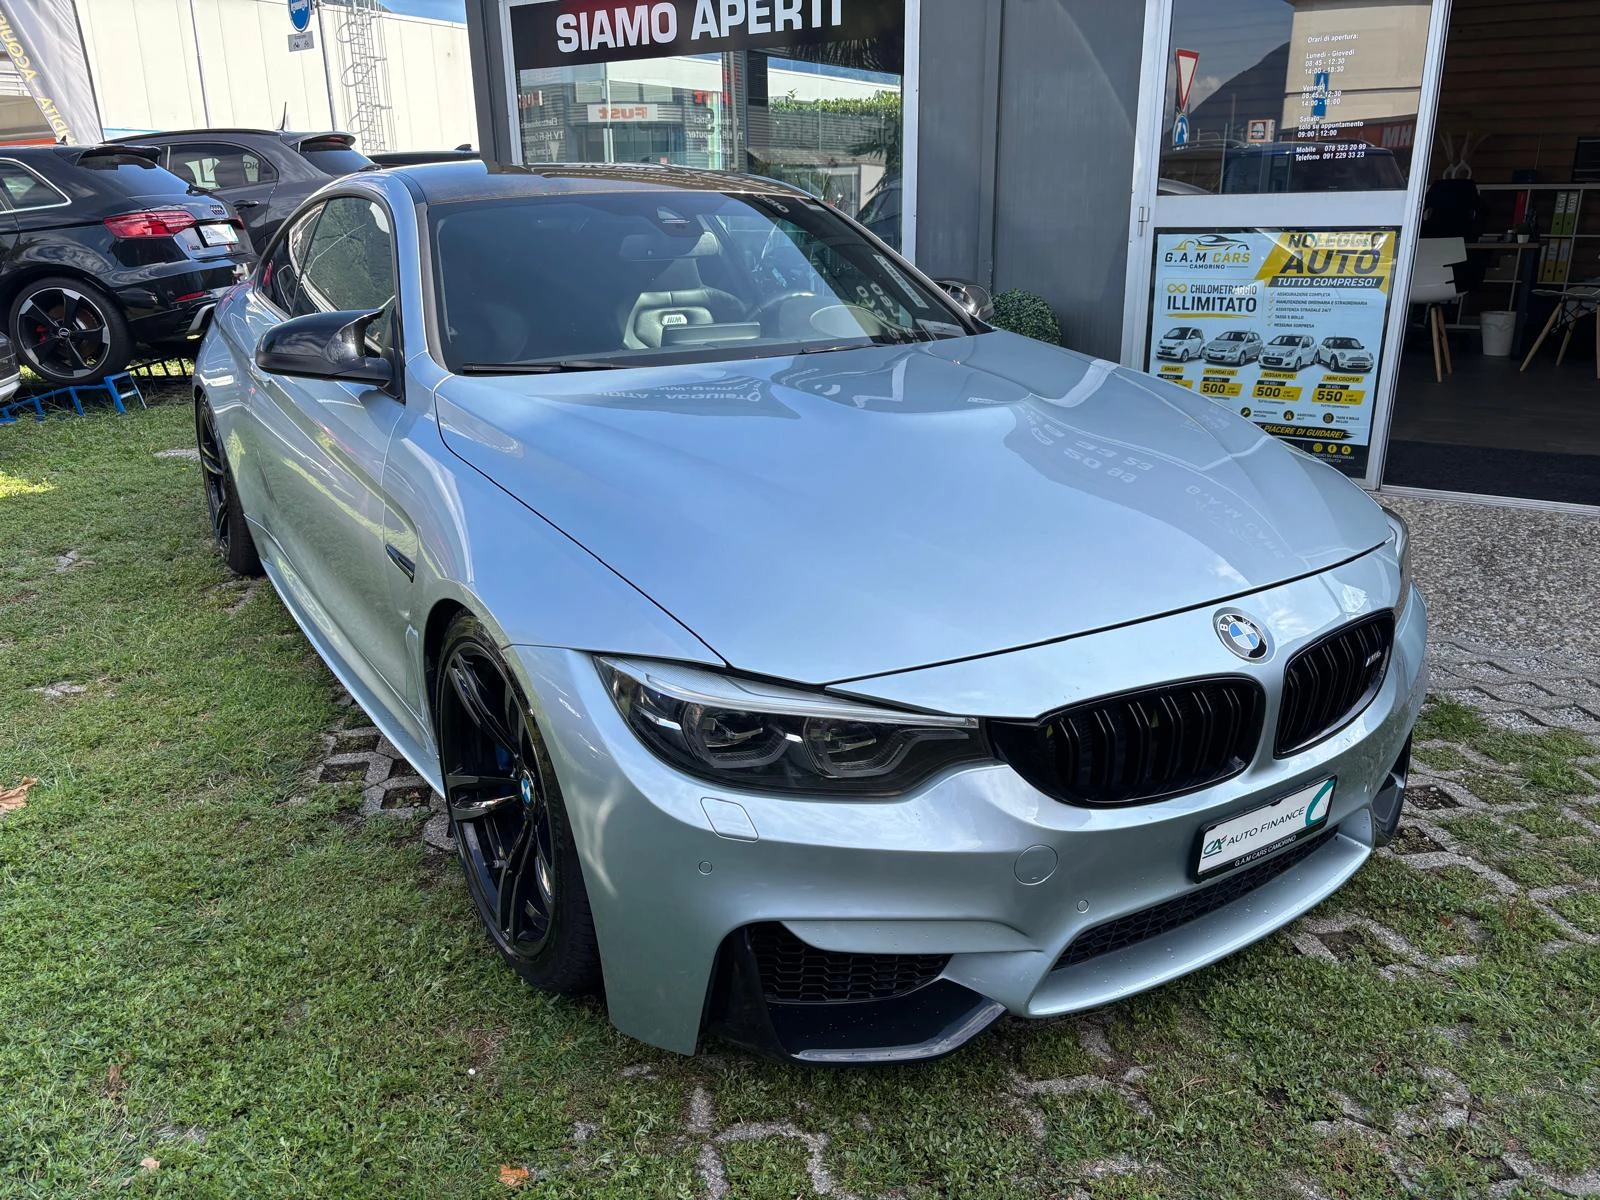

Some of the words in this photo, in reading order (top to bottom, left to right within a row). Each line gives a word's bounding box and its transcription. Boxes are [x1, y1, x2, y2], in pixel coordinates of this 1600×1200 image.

[556, 2, 677, 53] SIAMO
[1331, 33, 1359, 42] apertura:
[1328, 58, 1345, 66] 12:30
[1325, 90, 1342, 98] 12:30
[1321, 121, 1364, 130] appuntamento
[1298, 130, 1315, 138] 09:00
[1320, 129, 1337, 137] 12:00
[1165, 252, 1207, 263] G.A.M
[1212, 252, 1250, 263] CARS
[1279, 250, 1381, 274] AUTO
[1277, 278, 1310, 287] TUTTO
[1313, 278, 1376, 287] COMPRESO!
[1190, 284, 1257, 295] CHILOMETRAGGIO
[1167, 296, 1257, 312] ILLIMITATO
[1202, 383, 1226, 394] 500
[1257, 387, 1281, 398] 500
[1317, 390, 1343, 402] 550
[1264, 425, 1297, 435] PIACERE
[1296, 428, 1305, 436] DI
[1306, 429, 1344, 439] GUIDARE!
[1226, 828, 1258, 847] AUTO
[1260, 806, 1305, 833] FINANCE
[1252, 848, 1268, 860] CARS
[1267, 835, 1297, 854] CAMORINO
